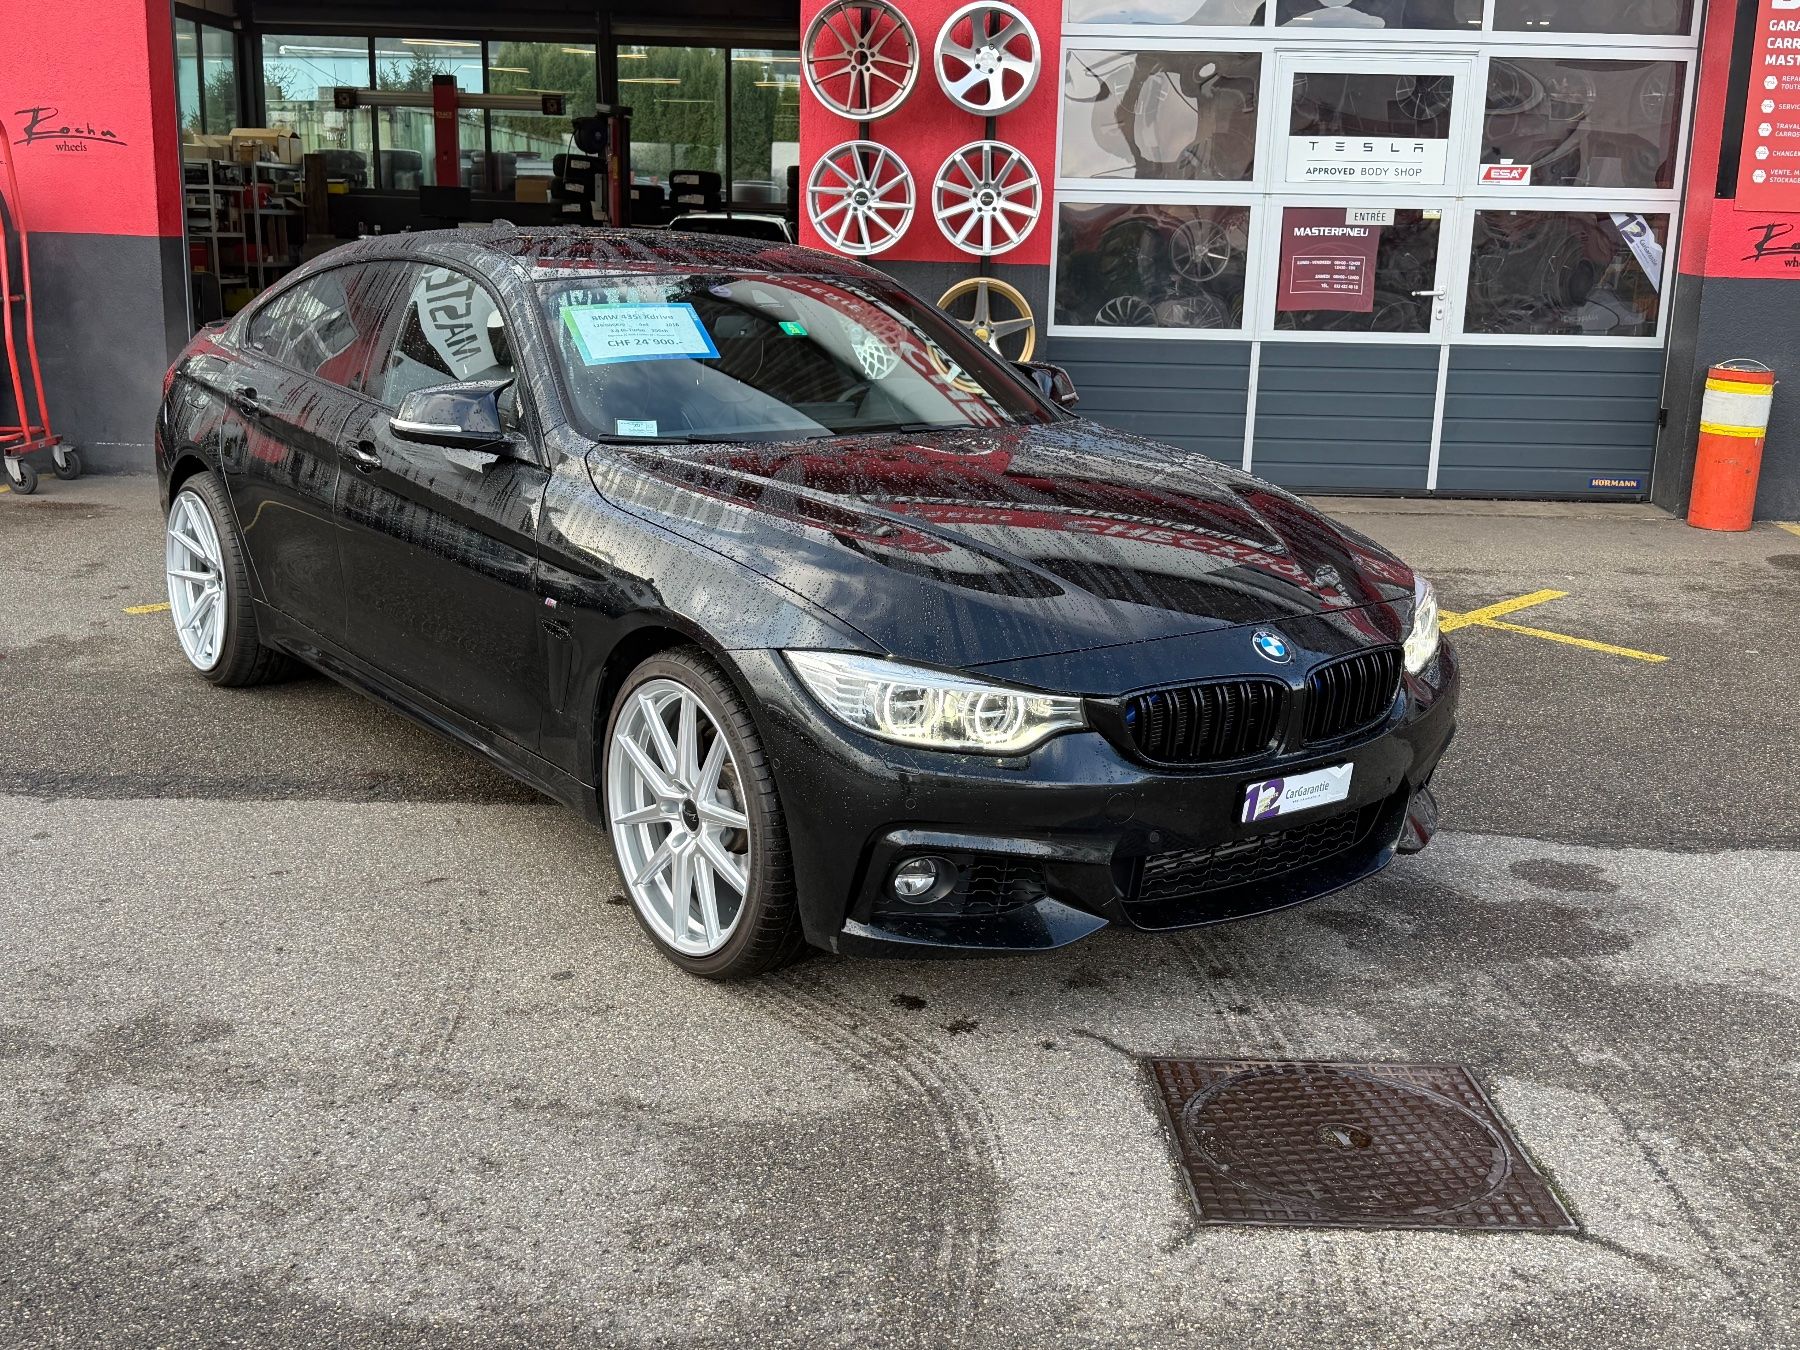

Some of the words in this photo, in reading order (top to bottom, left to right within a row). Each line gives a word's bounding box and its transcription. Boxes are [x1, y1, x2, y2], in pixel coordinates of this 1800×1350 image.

[55, 140, 88, 152] wheels
[1308, 141, 1424, 153] TESLA
[1305, 167, 1356, 176] APPROVED
[1360, 167, 1390, 177] BODY
[1394, 168, 1422, 177] SHOP
[1354, 210, 1387, 222] ENTRÉE
[1293, 226, 1369, 237] MASTERPNEU
[591, 313, 618, 321] BMW
[643, 312, 674, 321] Xdrive
[607, 339, 631, 347] CHF
[1244, 777, 1285, 822] 12
[1285, 780, 1330, 800] CarGarantie
